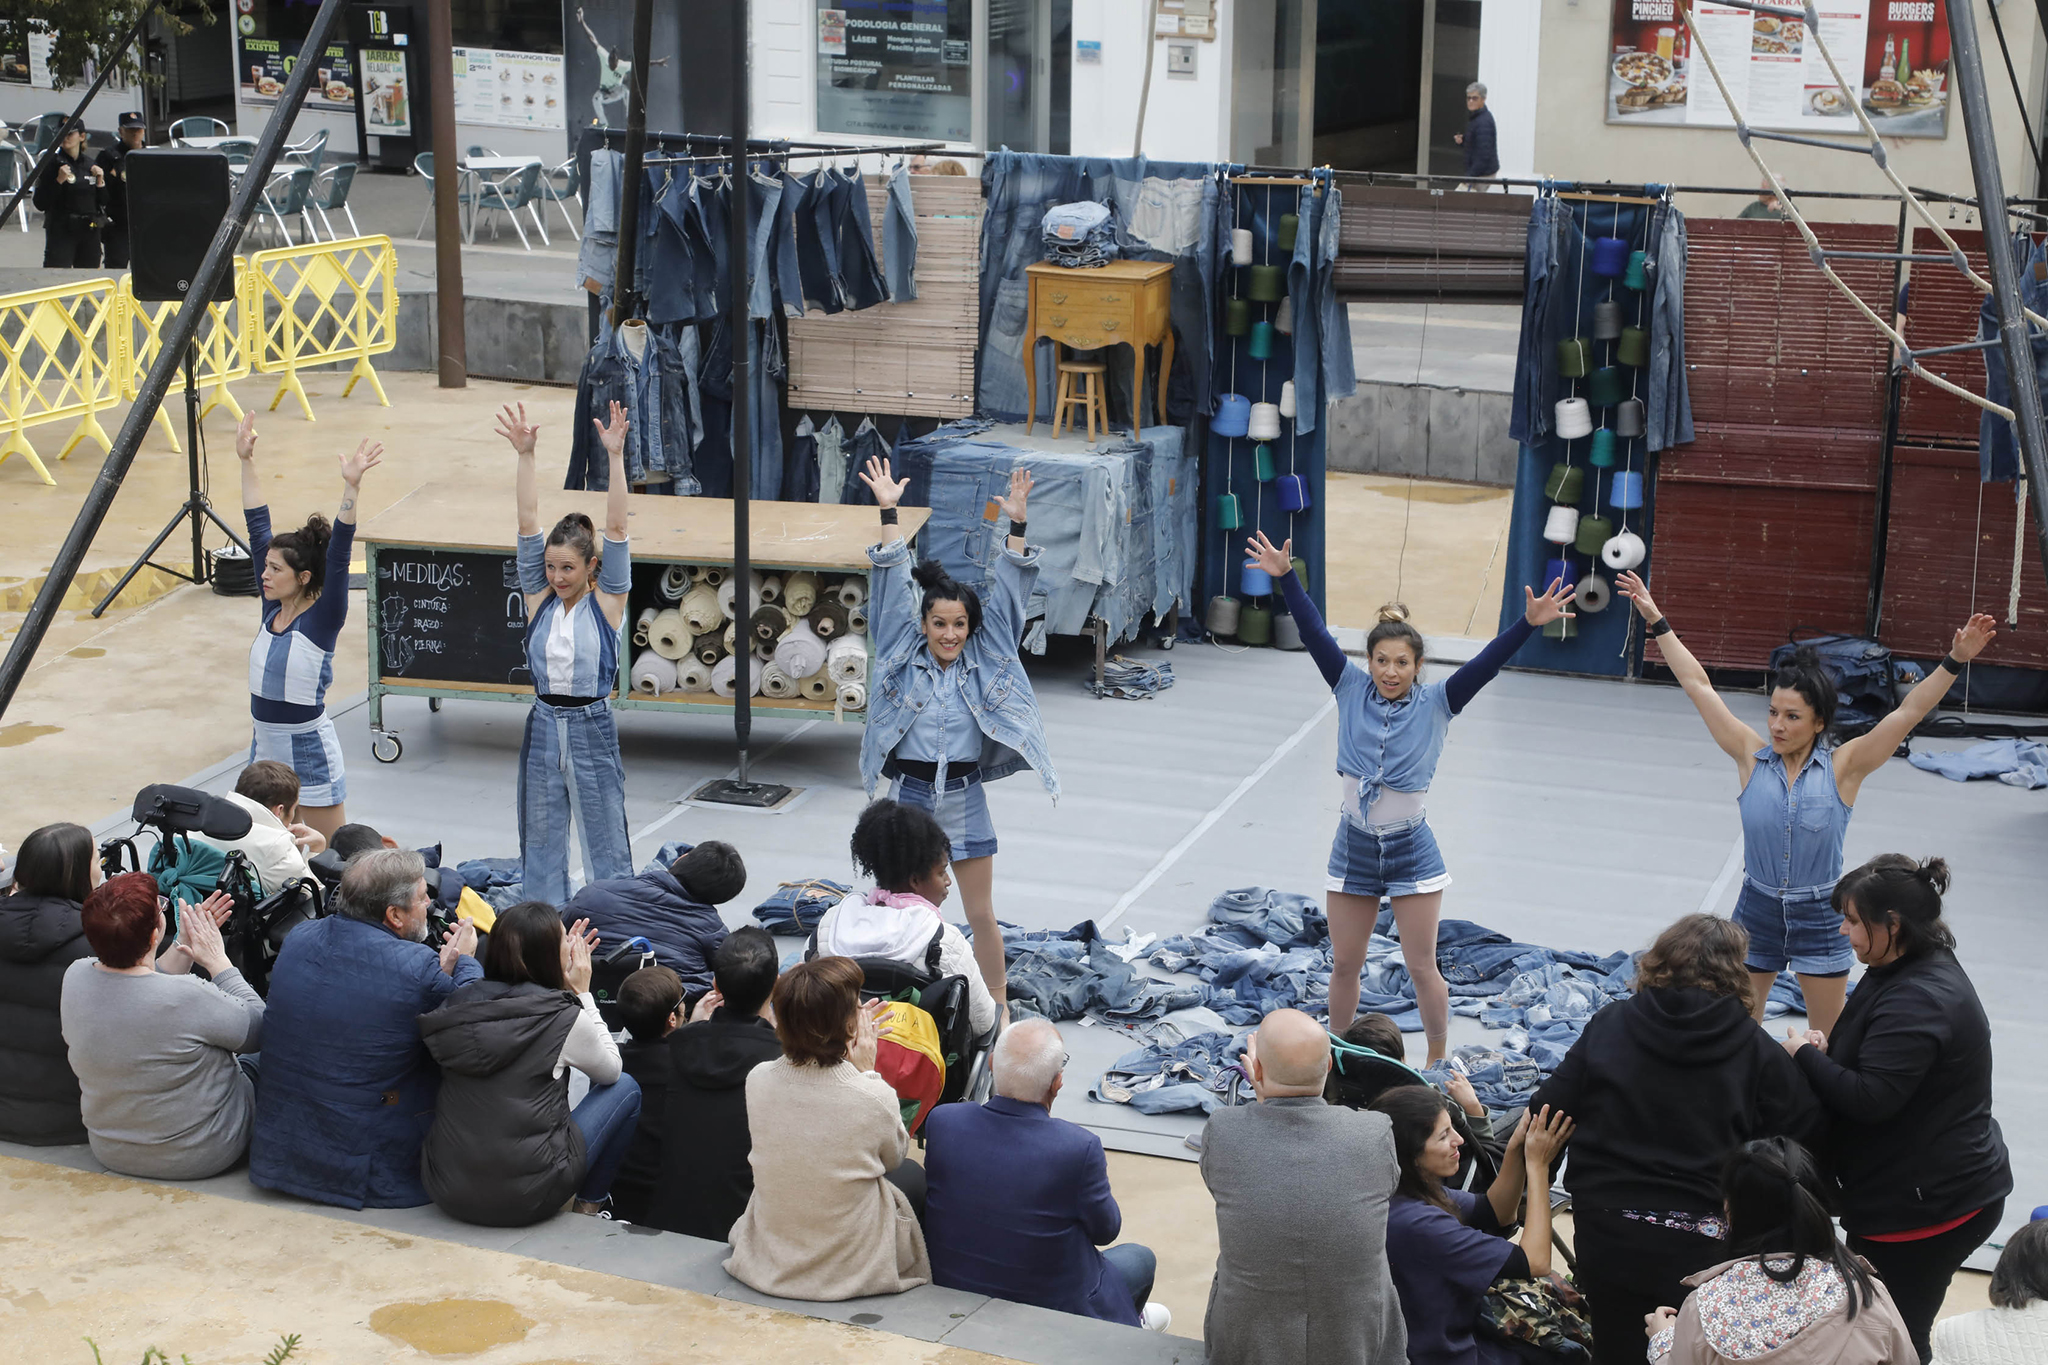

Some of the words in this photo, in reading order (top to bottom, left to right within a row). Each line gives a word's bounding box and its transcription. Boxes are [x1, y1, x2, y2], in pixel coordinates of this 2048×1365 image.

[1632, 3, 1674, 16] PINCHEO
[1888, 2, 1934, 15] BURGERS
[367, 10, 388, 34] TGB
[845, 19, 899, 30] PODOLOGIA
[900, 22, 944, 32] GENERAL
[852, 34, 877, 44] LÁSER
[887, 35, 913, 45] Hongos
[245, 43, 280, 52] EXISTEN
[915, 46, 940, 54] plantar
[366, 50, 400, 62] JARRAS
[495, 52, 543, 61] DESAYUNOS
[850, 60, 883, 68] POSTURAL
[895, 75, 935, 83] PLANTILLAS
[888, 82, 952, 92] PERSONALIZADAS
[911, 1016, 919, 1028] A
